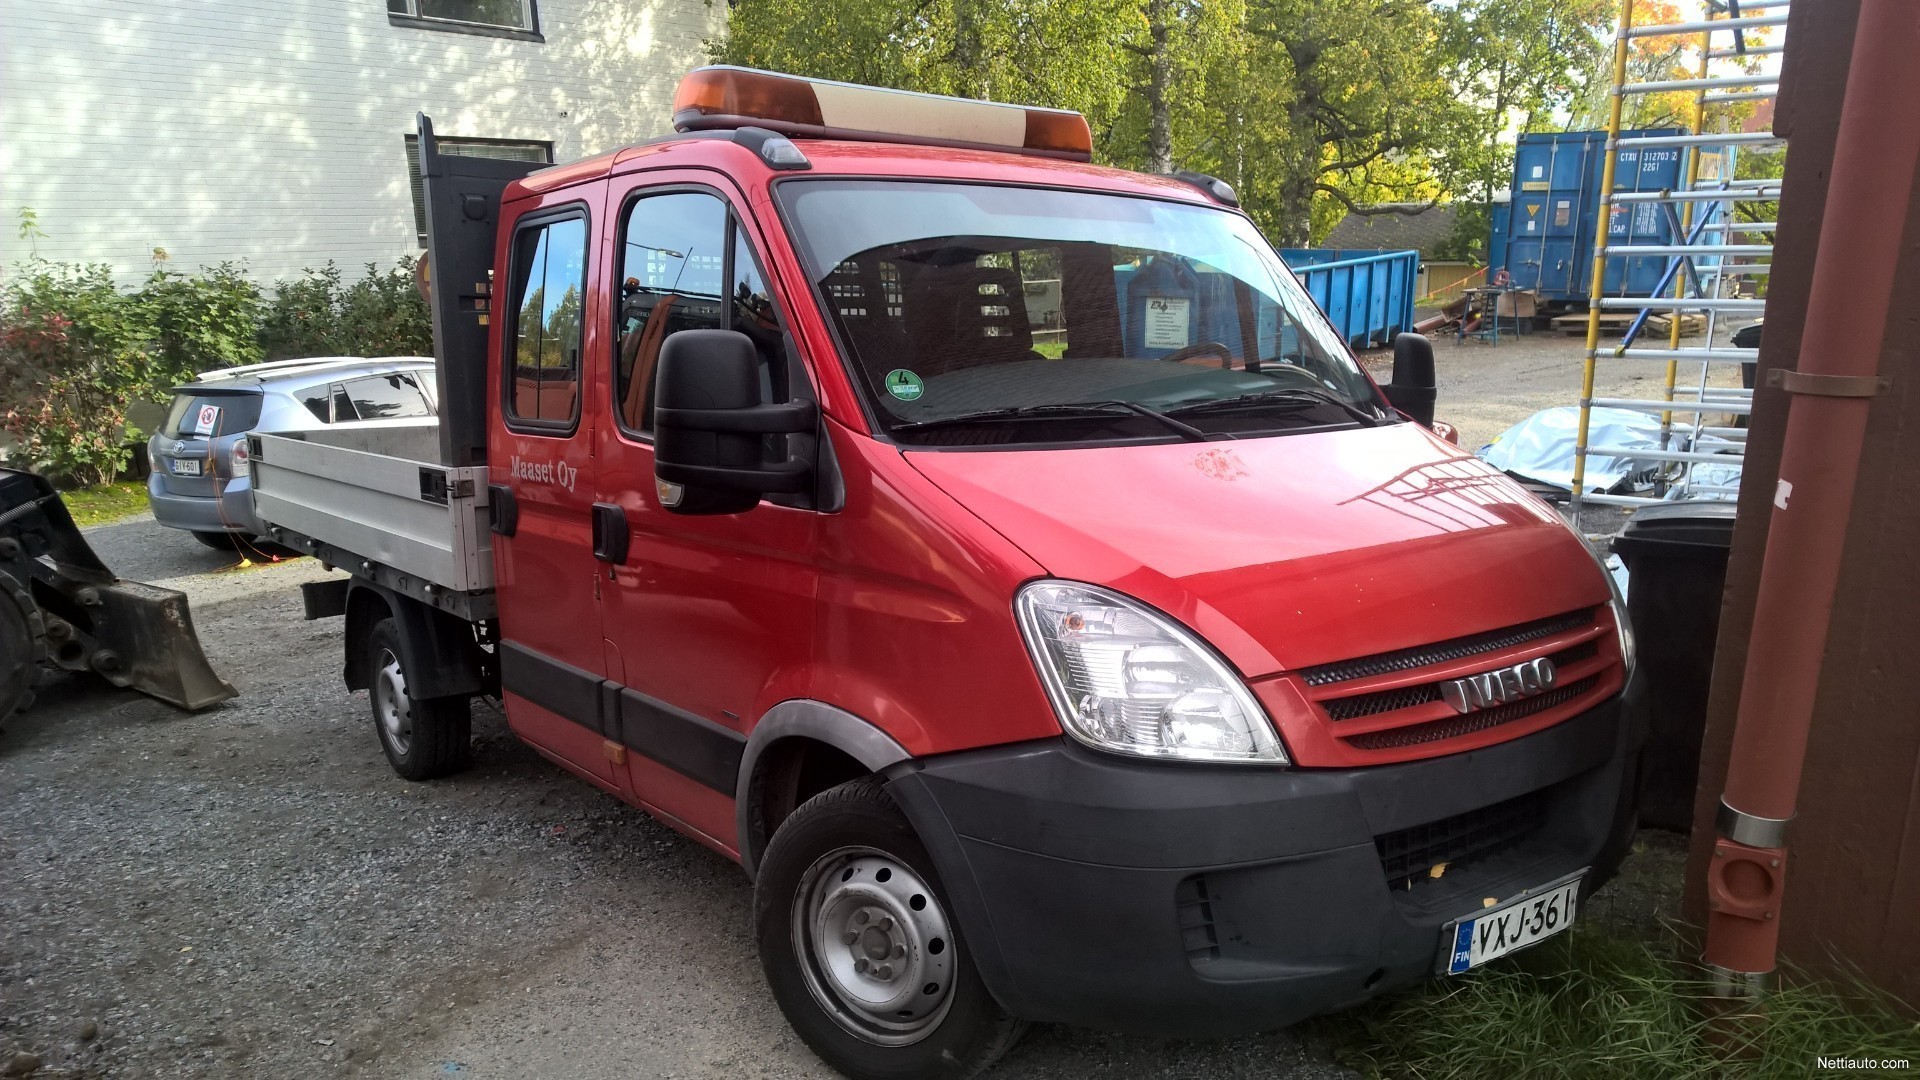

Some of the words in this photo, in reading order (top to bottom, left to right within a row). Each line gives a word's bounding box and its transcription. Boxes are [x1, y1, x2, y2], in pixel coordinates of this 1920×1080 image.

[1620, 152, 1637, 161] CTXU
[1644, 152, 1669, 161] 312703
[898, 371, 909, 384] 4
[510, 455, 554, 484] Maaset
[557, 460, 577, 493] Oy
[1442, 657, 1556, 714] IVECO
[1480, 888, 1571, 956] VXJ-361
[1454, 951, 1470, 963] FIN
